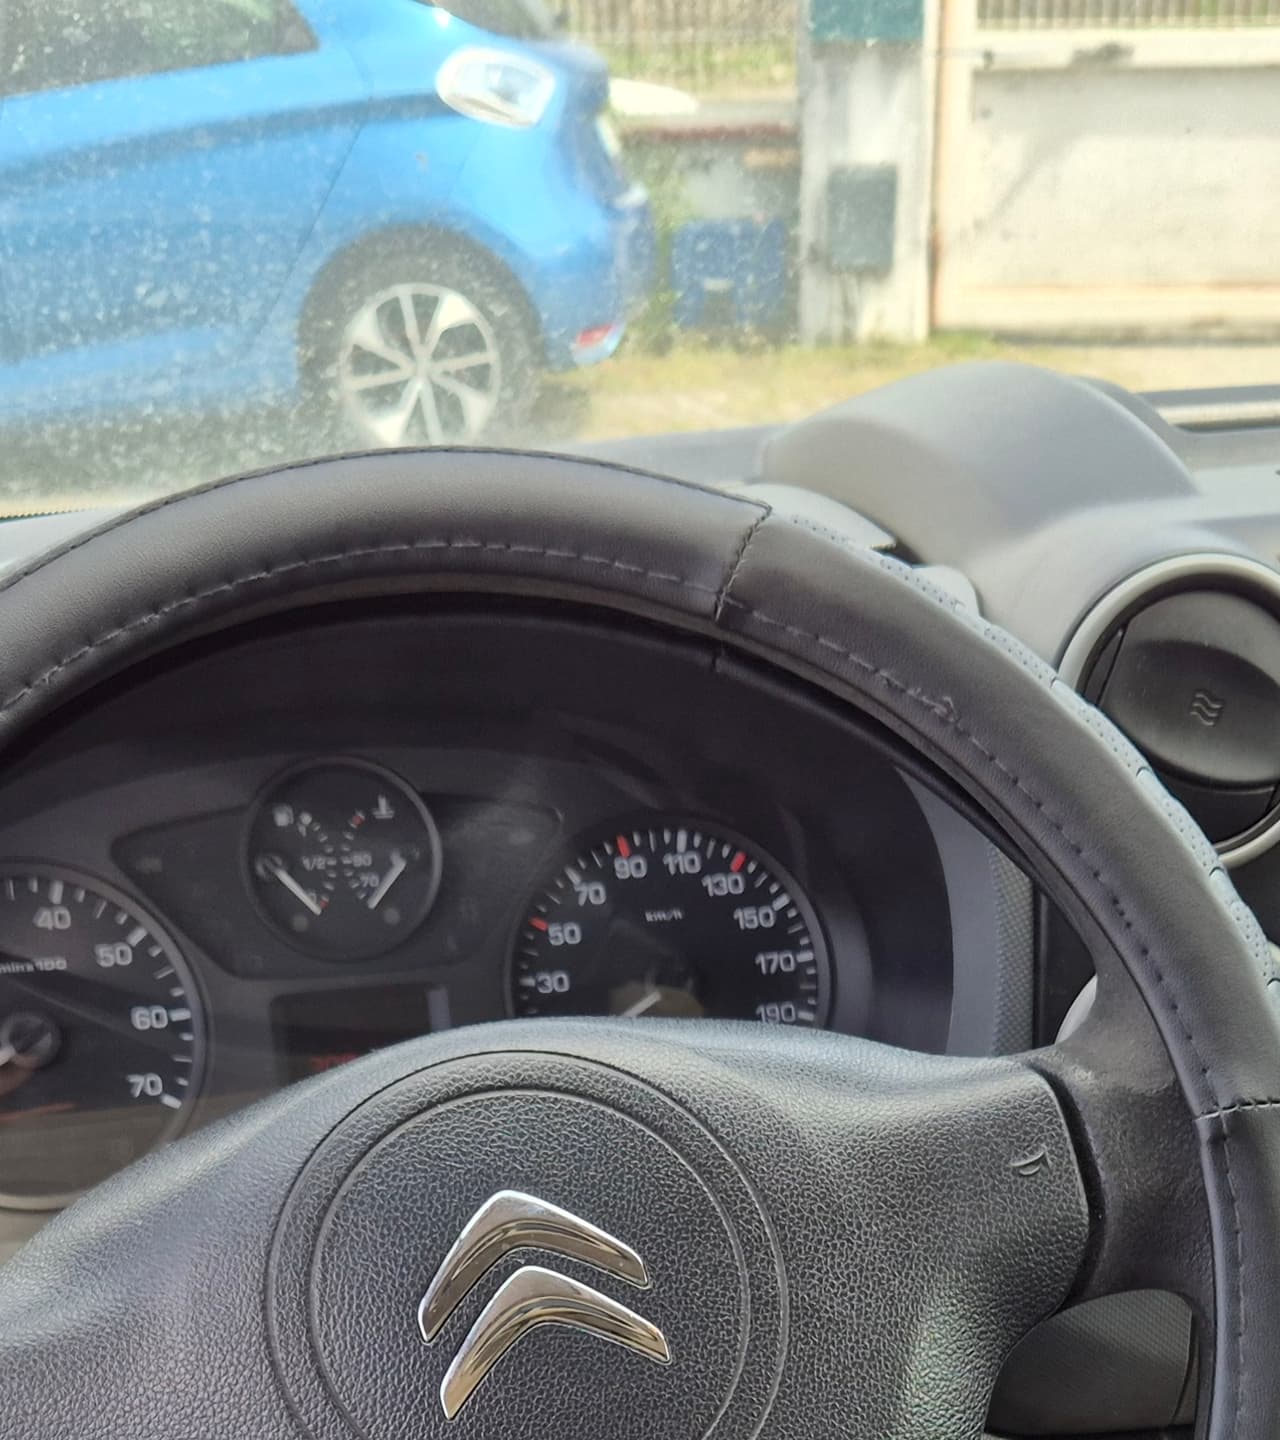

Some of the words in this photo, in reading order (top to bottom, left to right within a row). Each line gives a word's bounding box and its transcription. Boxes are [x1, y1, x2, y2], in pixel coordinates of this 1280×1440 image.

[614, 856, 647, 879] 90
[663, 852, 702, 875] 110
[360, 873, 380, 888] 70
[702, 874, 745, 897] 130
[577, 882, 607, 905] 70
[35, 906, 72, 931] 40
[645, 909, 684, 922] km/h
[733, 906, 776, 930] 150
[547, 923, 582, 946] 50
[95, 943, 133, 968] 50
[755, 952, 796, 974] 170
[535, 972, 570, 993] 30
[131, 1006, 168, 1031] 60
[755, 1003, 796, 1024] 190
[127, 1074, 163, 1098] 70
